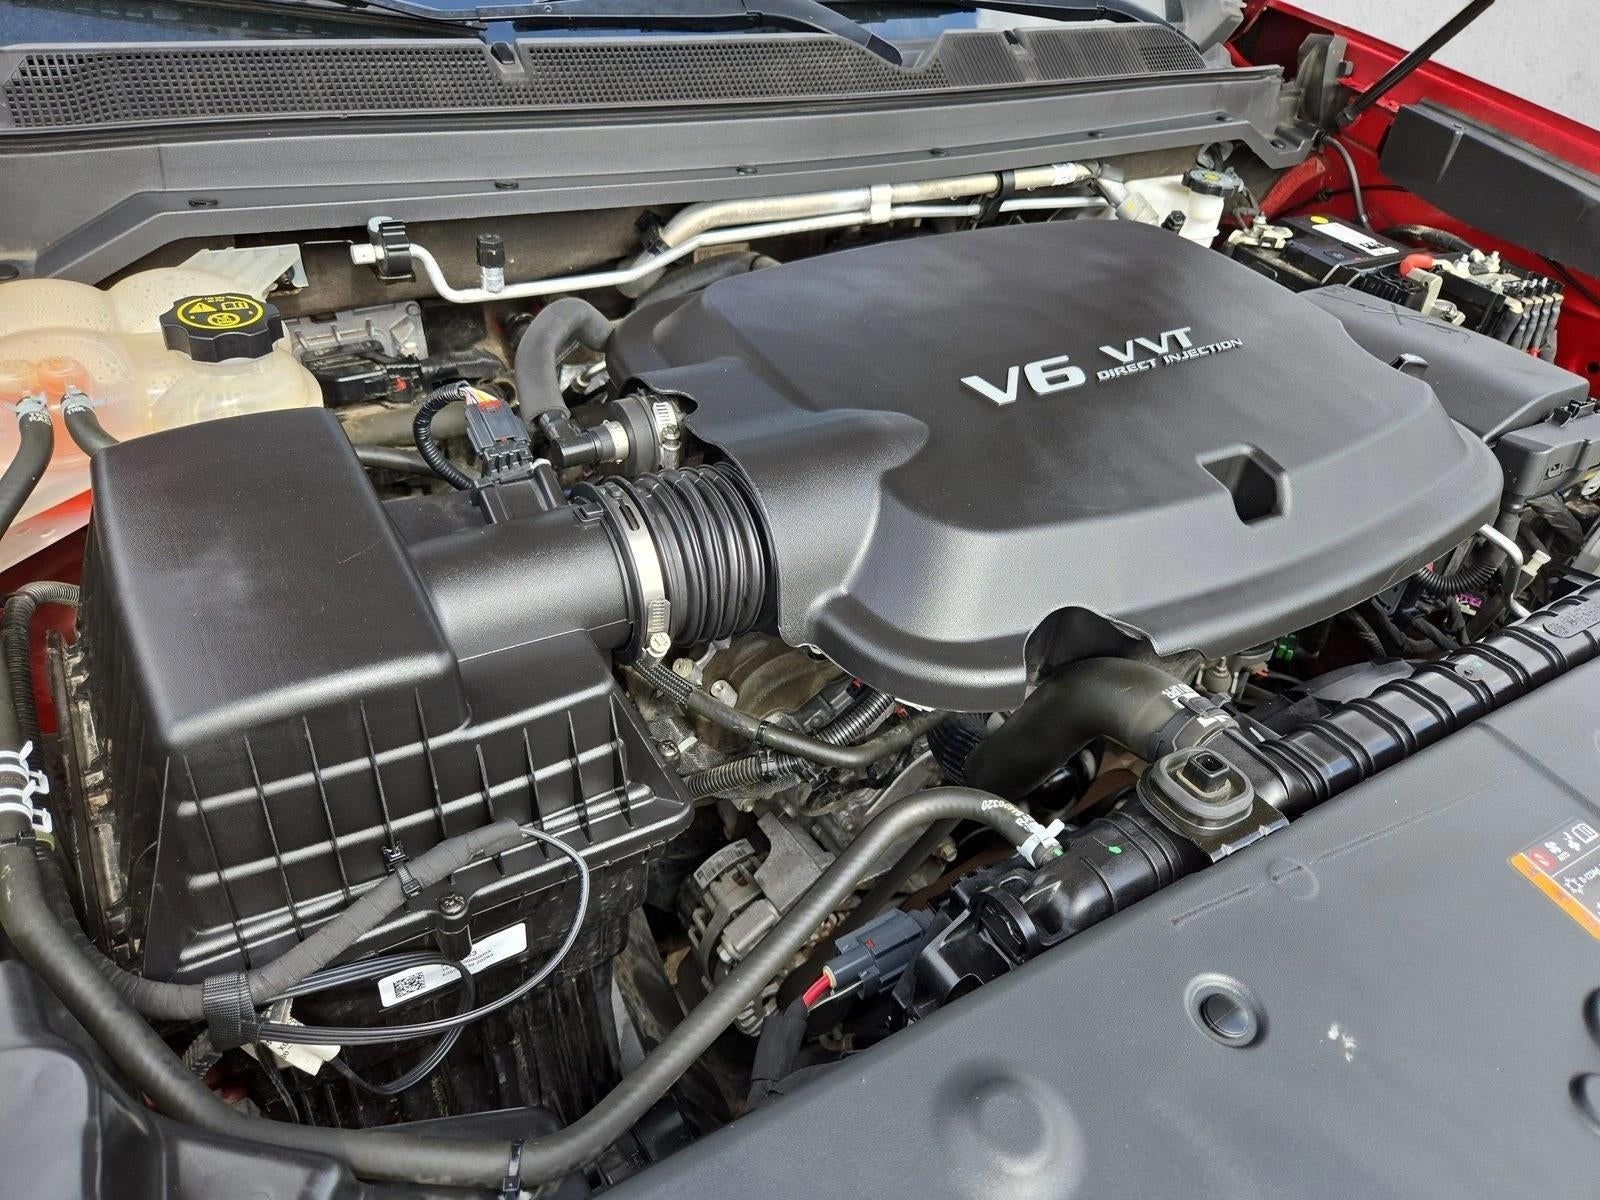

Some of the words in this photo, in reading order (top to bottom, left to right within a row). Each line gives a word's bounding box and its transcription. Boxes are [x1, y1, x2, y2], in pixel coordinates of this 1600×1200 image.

[960, 354, 1086, 406] V6
[1098, 326, 1193, 364] VVT
[1096, 357, 1158, 382] DIRECT
[1162, 337, 1244, 366] INJECTION
